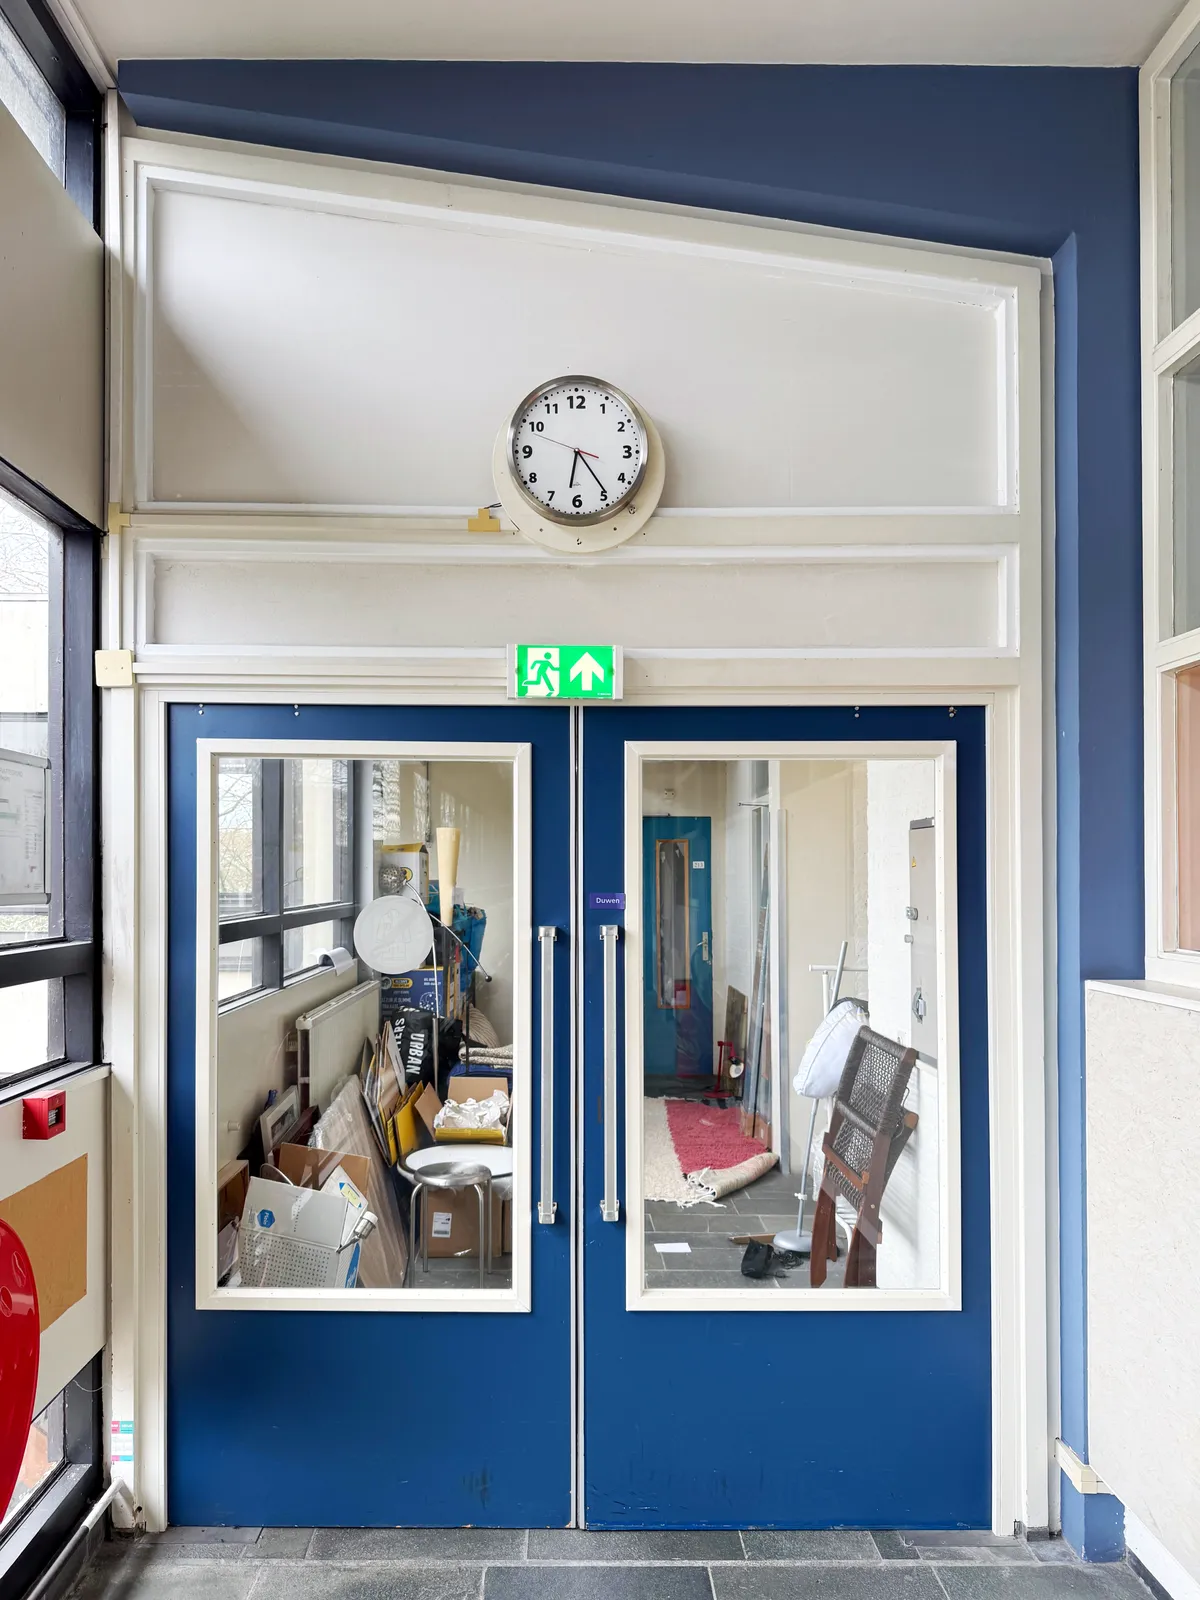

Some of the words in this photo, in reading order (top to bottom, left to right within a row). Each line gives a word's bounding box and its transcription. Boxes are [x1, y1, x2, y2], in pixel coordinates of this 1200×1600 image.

[566, 396, 586, 409] 12
[544, 404, 559, 414] 11
[600, 404, 606, 414] 1
[529, 422, 545, 432] 10
[617, 422, 625, 432] 2
[522, 445, 533, 459] 9
[622, 445, 632, 459] 3
[529, 472, 537, 483] 8
[617, 473, 626, 483] 4
[547, 491, 555, 501] 7
[600, 491, 607, 501] 5
[572, 495, 583, 508] 6
[394, 1018, 405, 1051] TERS
[406, 1033, 425, 1075] URBAN
